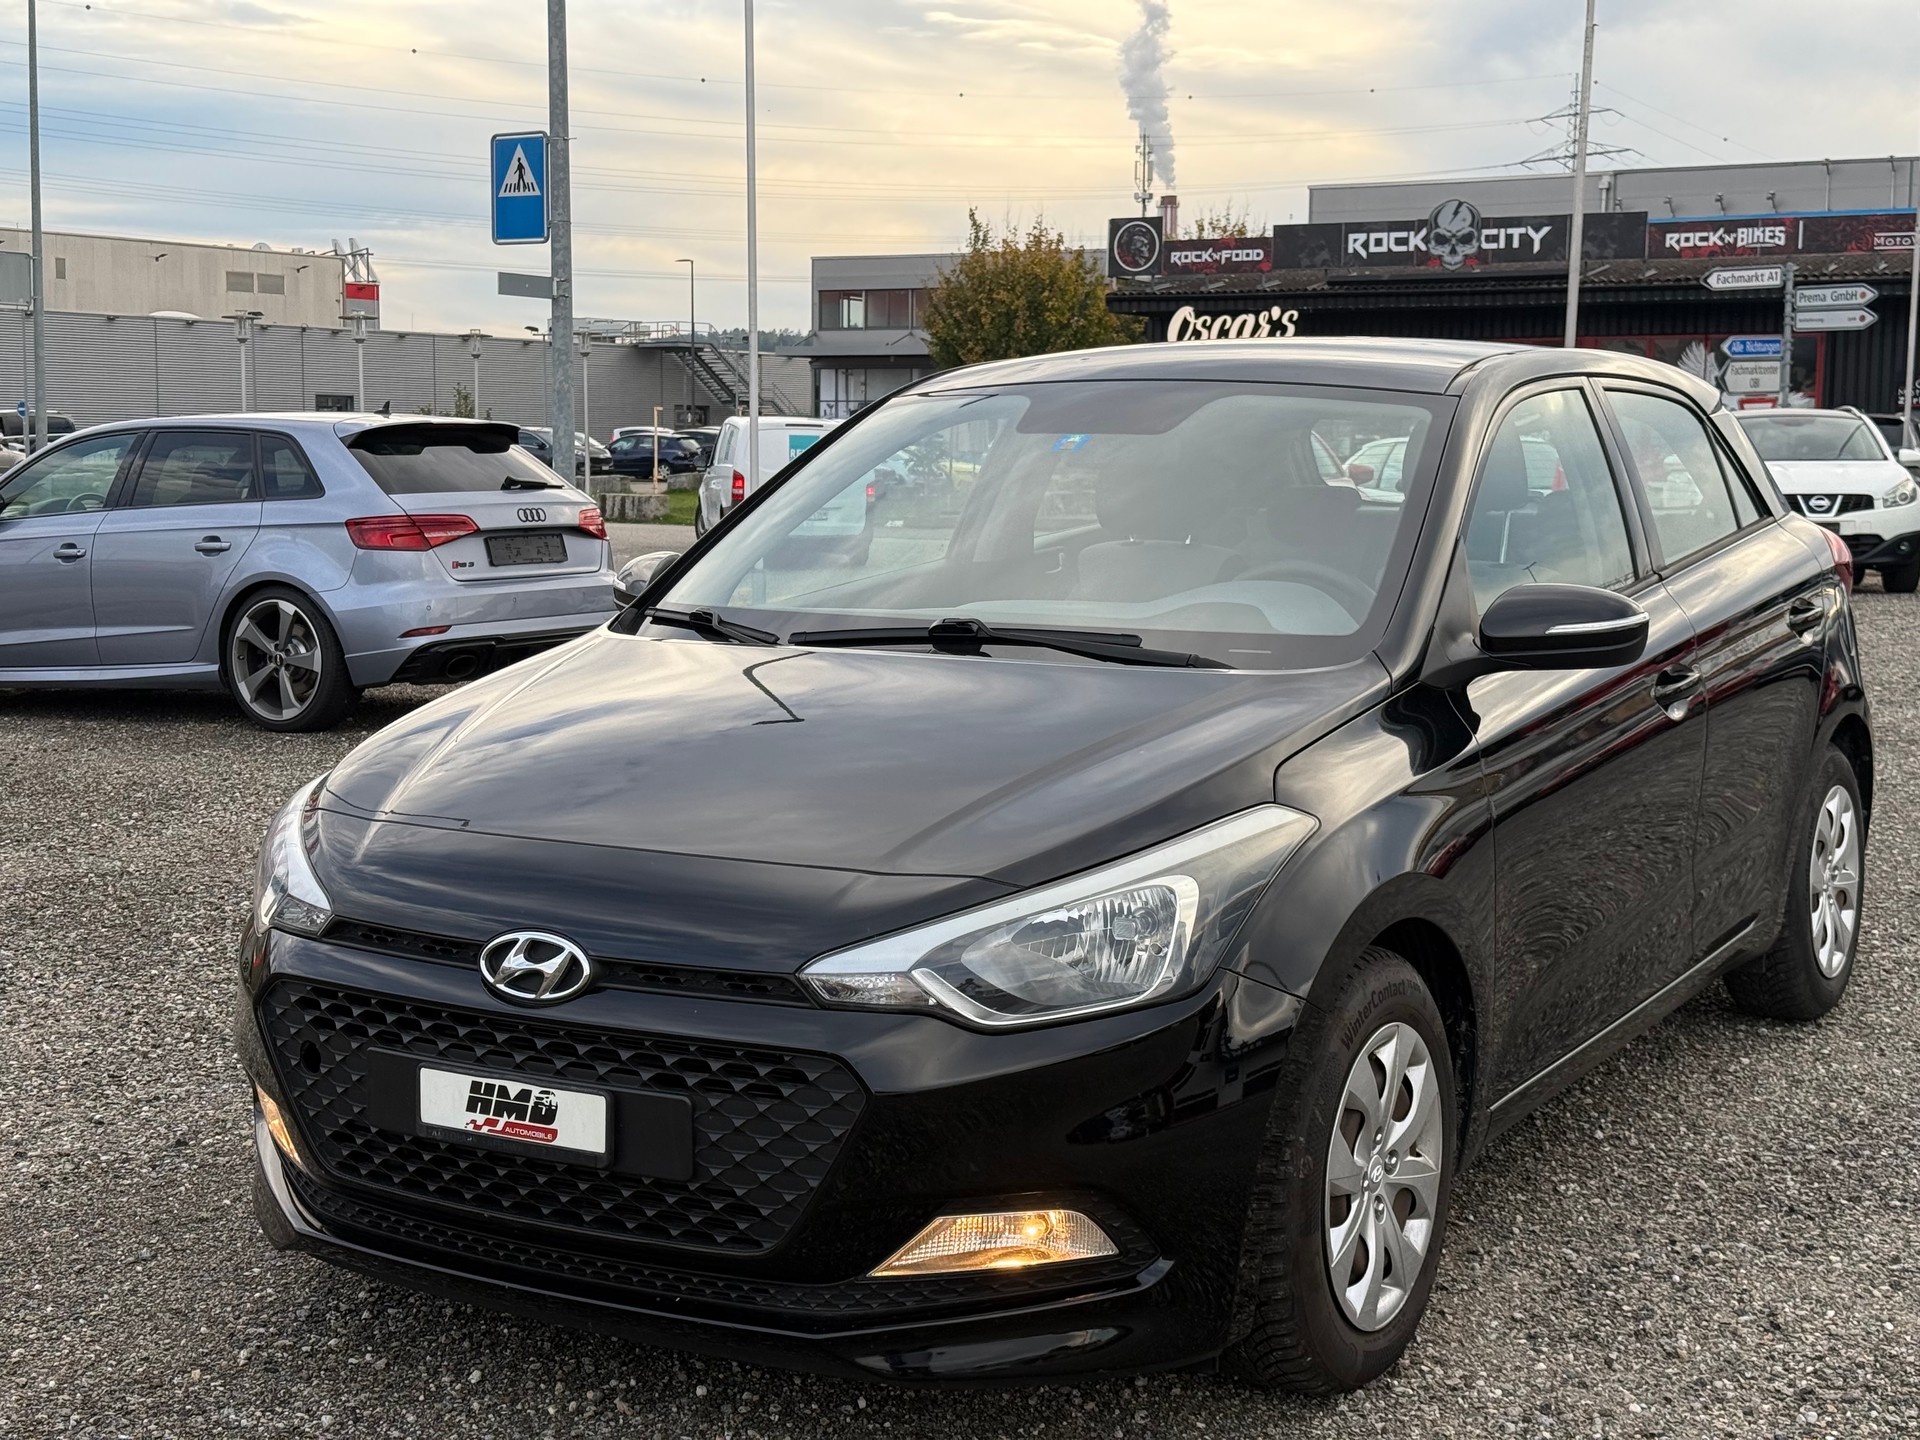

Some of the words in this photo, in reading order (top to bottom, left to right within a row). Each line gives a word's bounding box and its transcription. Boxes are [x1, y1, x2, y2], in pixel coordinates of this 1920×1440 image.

[1348, 227, 1428, 260] ROCK
[1481, 226, 1552, 255] CITY
[1716, 271, 1765, 285] Fachmarkt
[1767, 270, 1779, 282] A1
[1799, 292, 1827, 304] Prema
[1830, 290, 1858, 302] GmbH
[1167, 305, 1299, 342] Oscar's
[1731, 341, 1745, 353] Alle
[1745, 340, 1780, 355] Richtungen
[1340, 979, 1406, 1050] WinterContact
[504, 1126, 552, 1140] AUTOMOBILE
